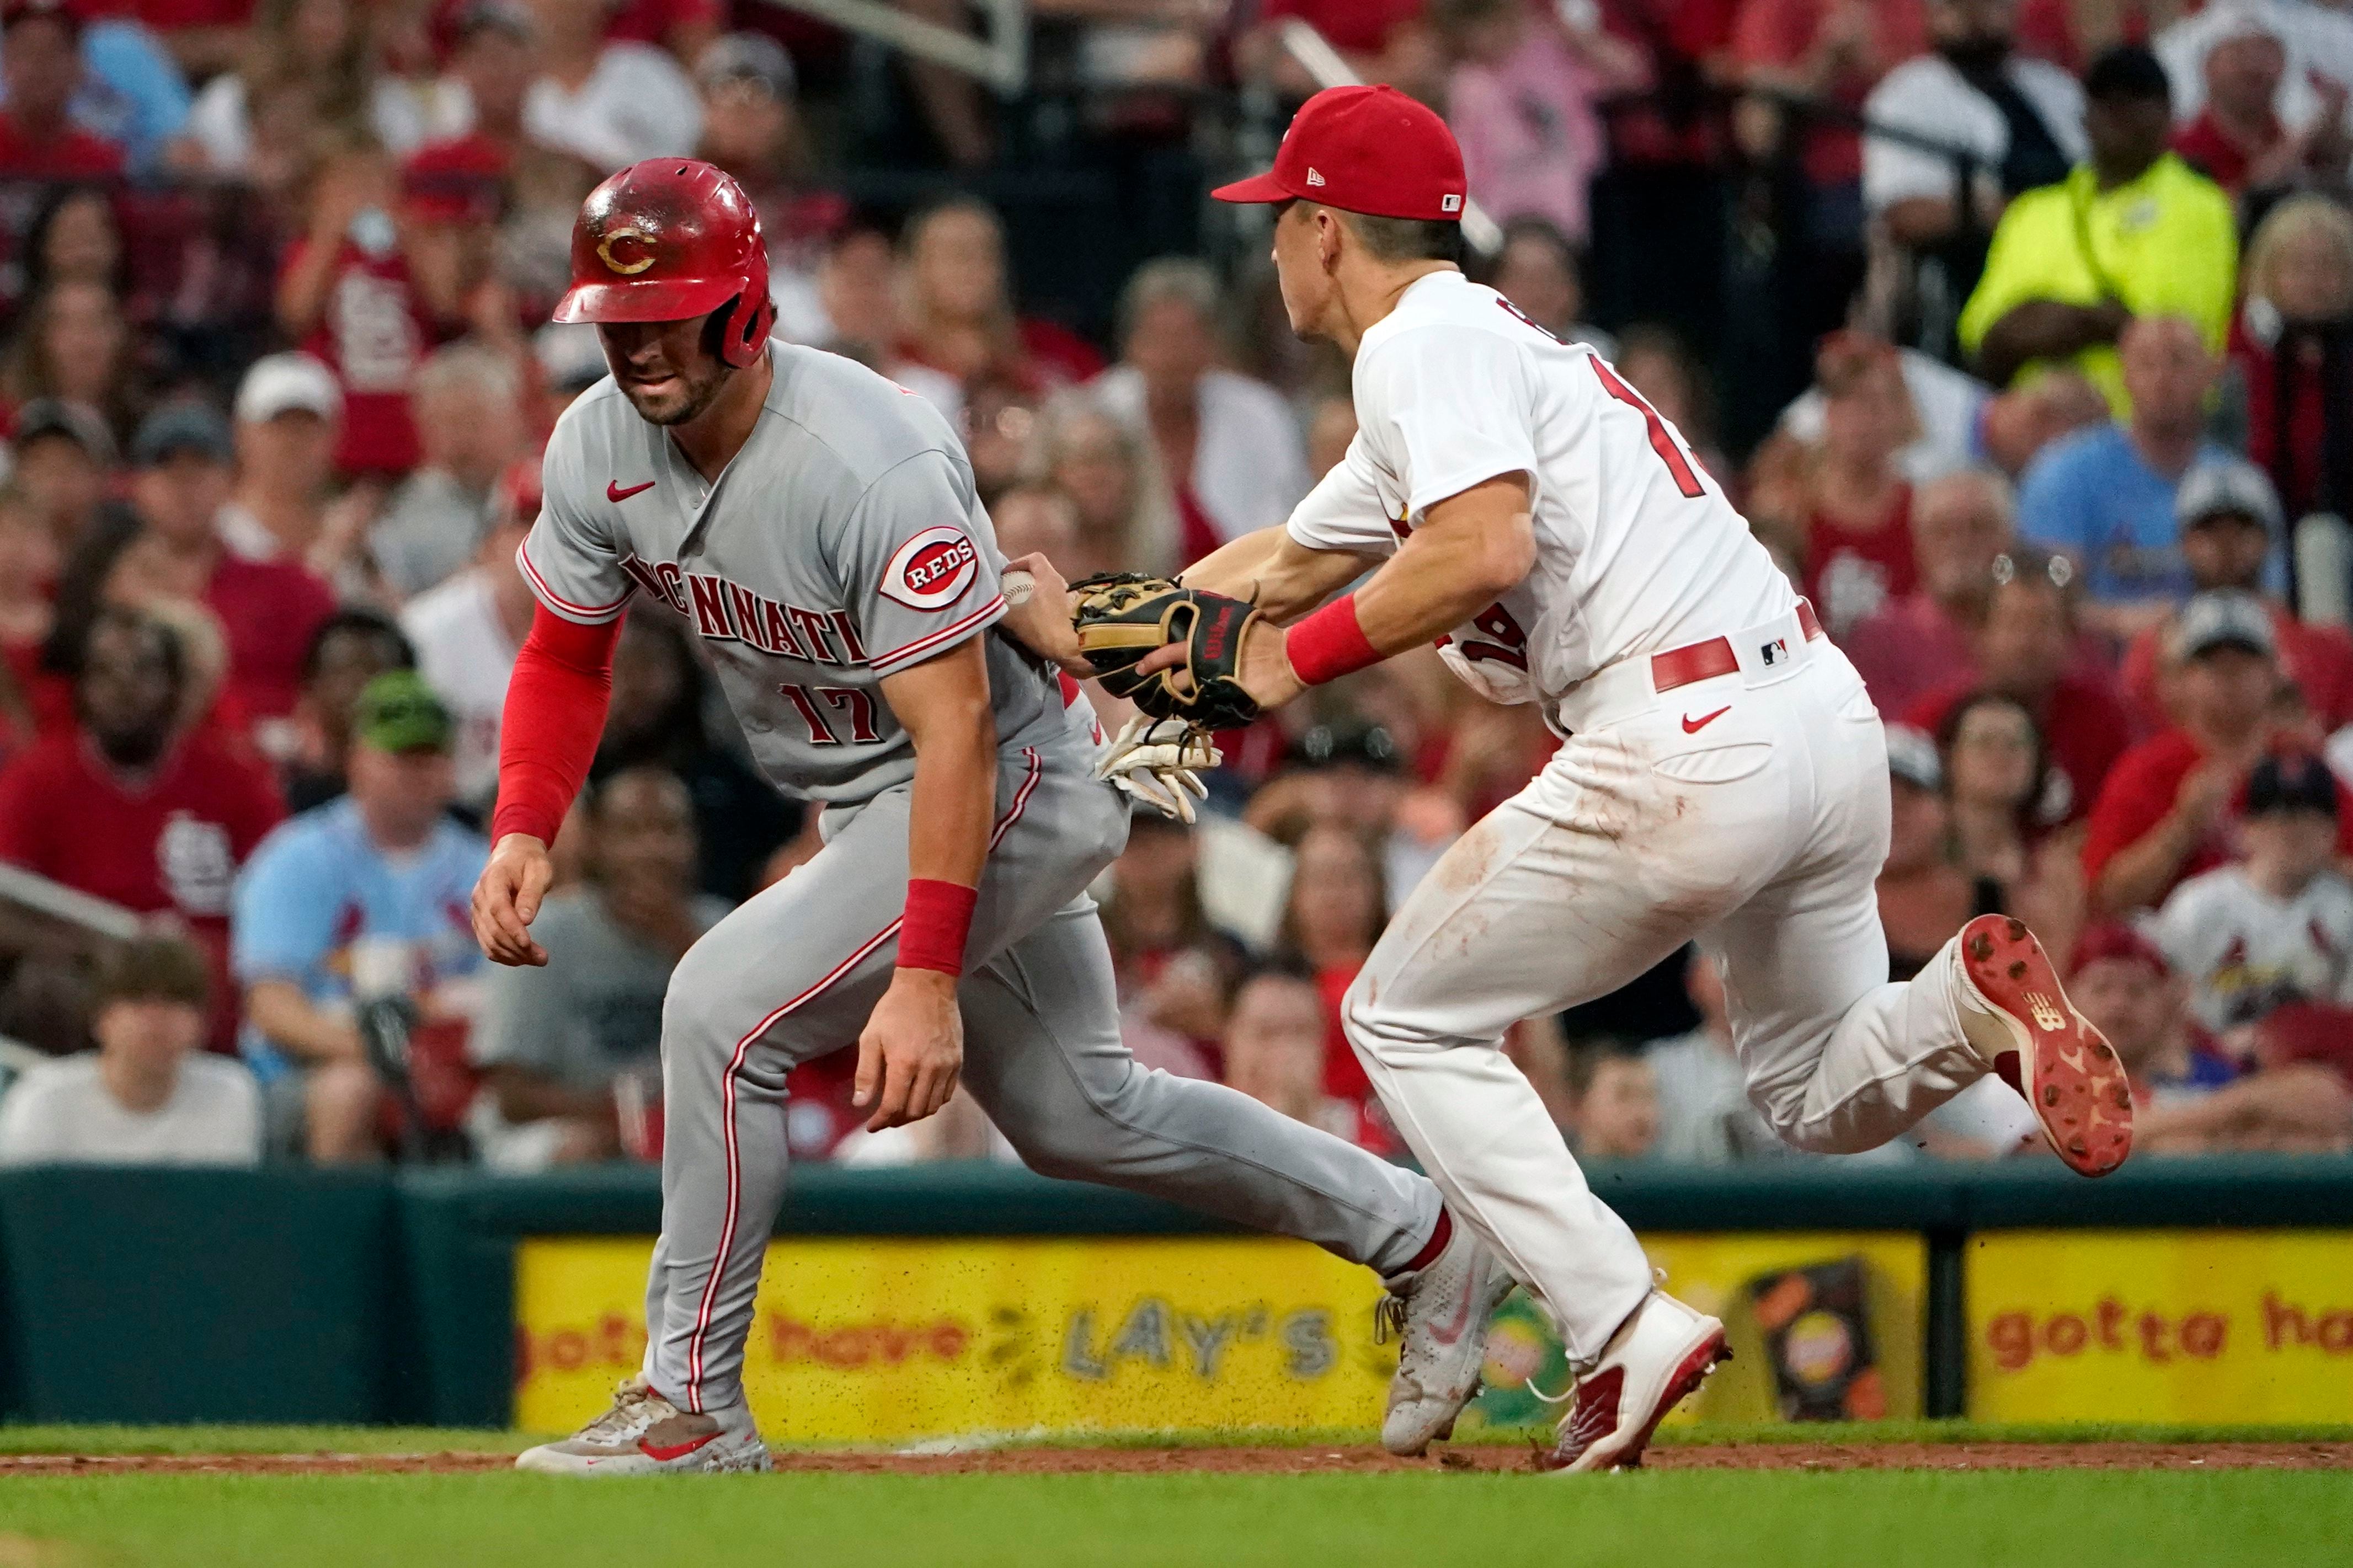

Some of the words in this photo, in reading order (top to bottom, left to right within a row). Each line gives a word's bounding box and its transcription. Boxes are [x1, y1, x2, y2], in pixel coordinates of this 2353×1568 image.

[597, 227, 657, 275] C
[906, 539, 974, 589] REDS
[778, 682, 886, 746] 17
[1987, 1296, 2228, 1373] gotta
